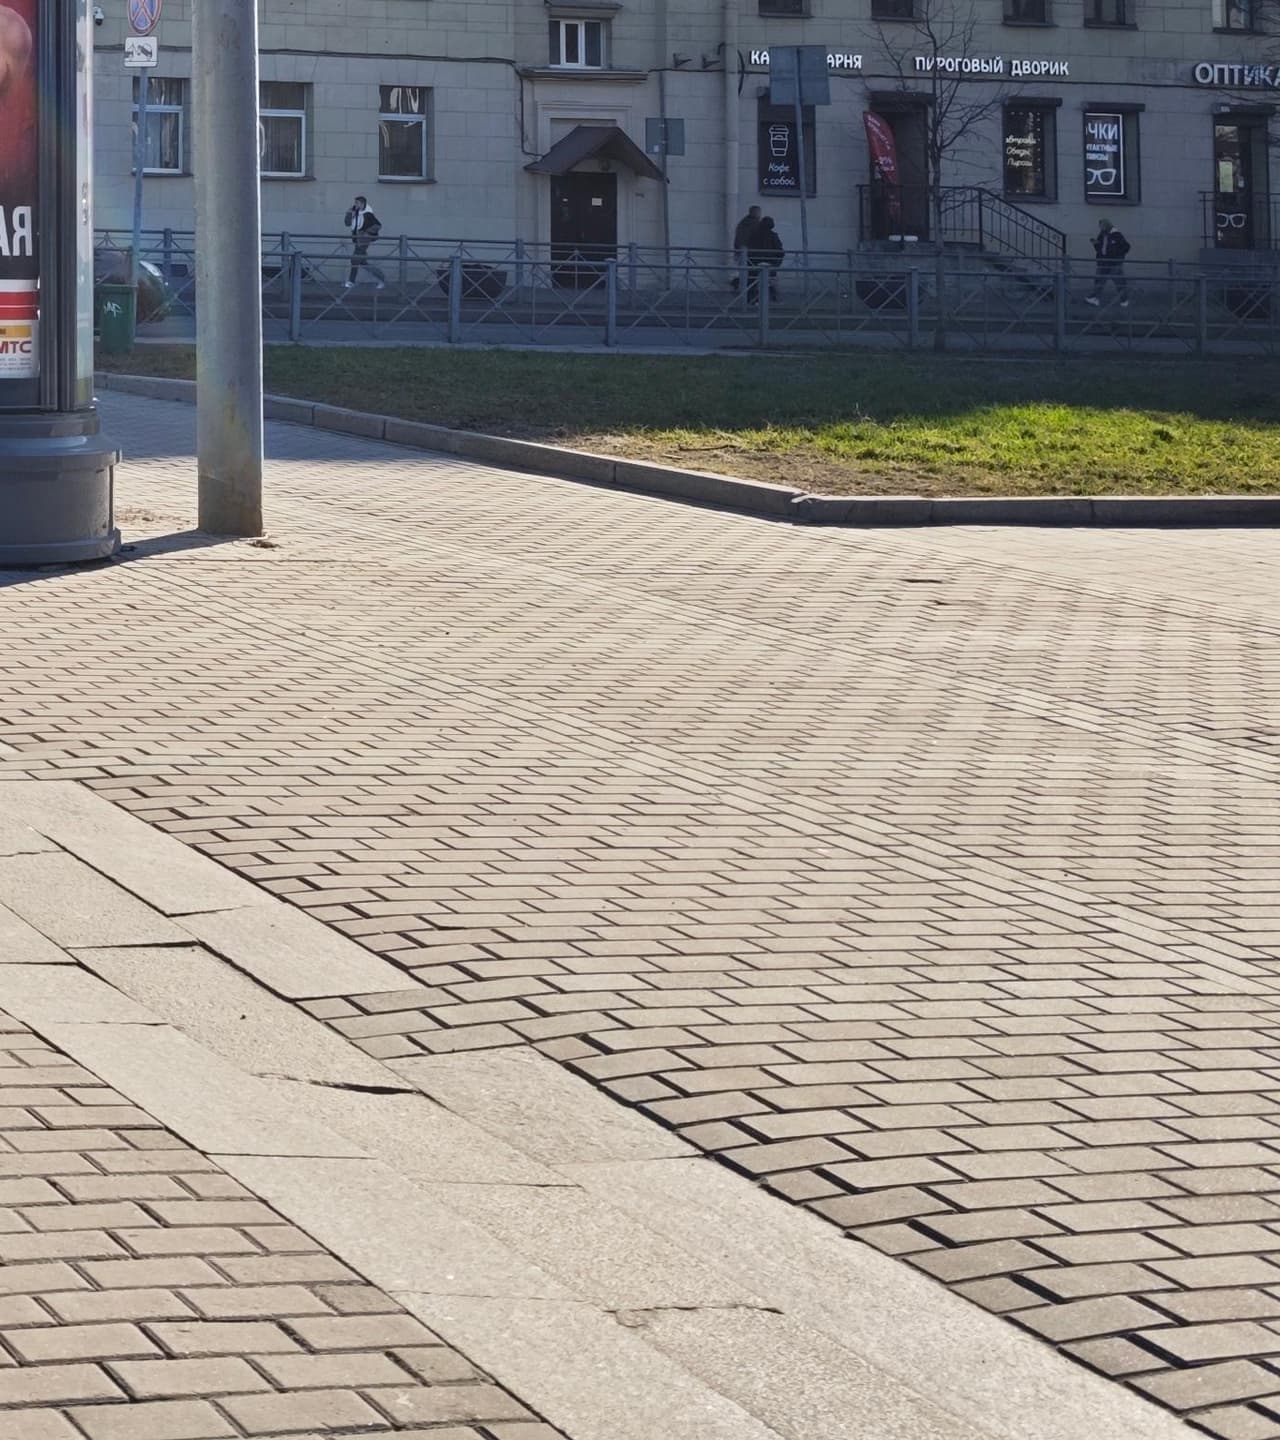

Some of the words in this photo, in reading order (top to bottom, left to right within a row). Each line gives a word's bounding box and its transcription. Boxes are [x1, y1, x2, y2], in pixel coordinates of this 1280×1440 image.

[915, 56, 1003, 75] ПИРОГОВЫЙ
[1011, 60, 1069, 76] ДВОРИК
[1085, 123, 1118, 140] ЧКИ
[768, 162, 790, 173] Кофе
